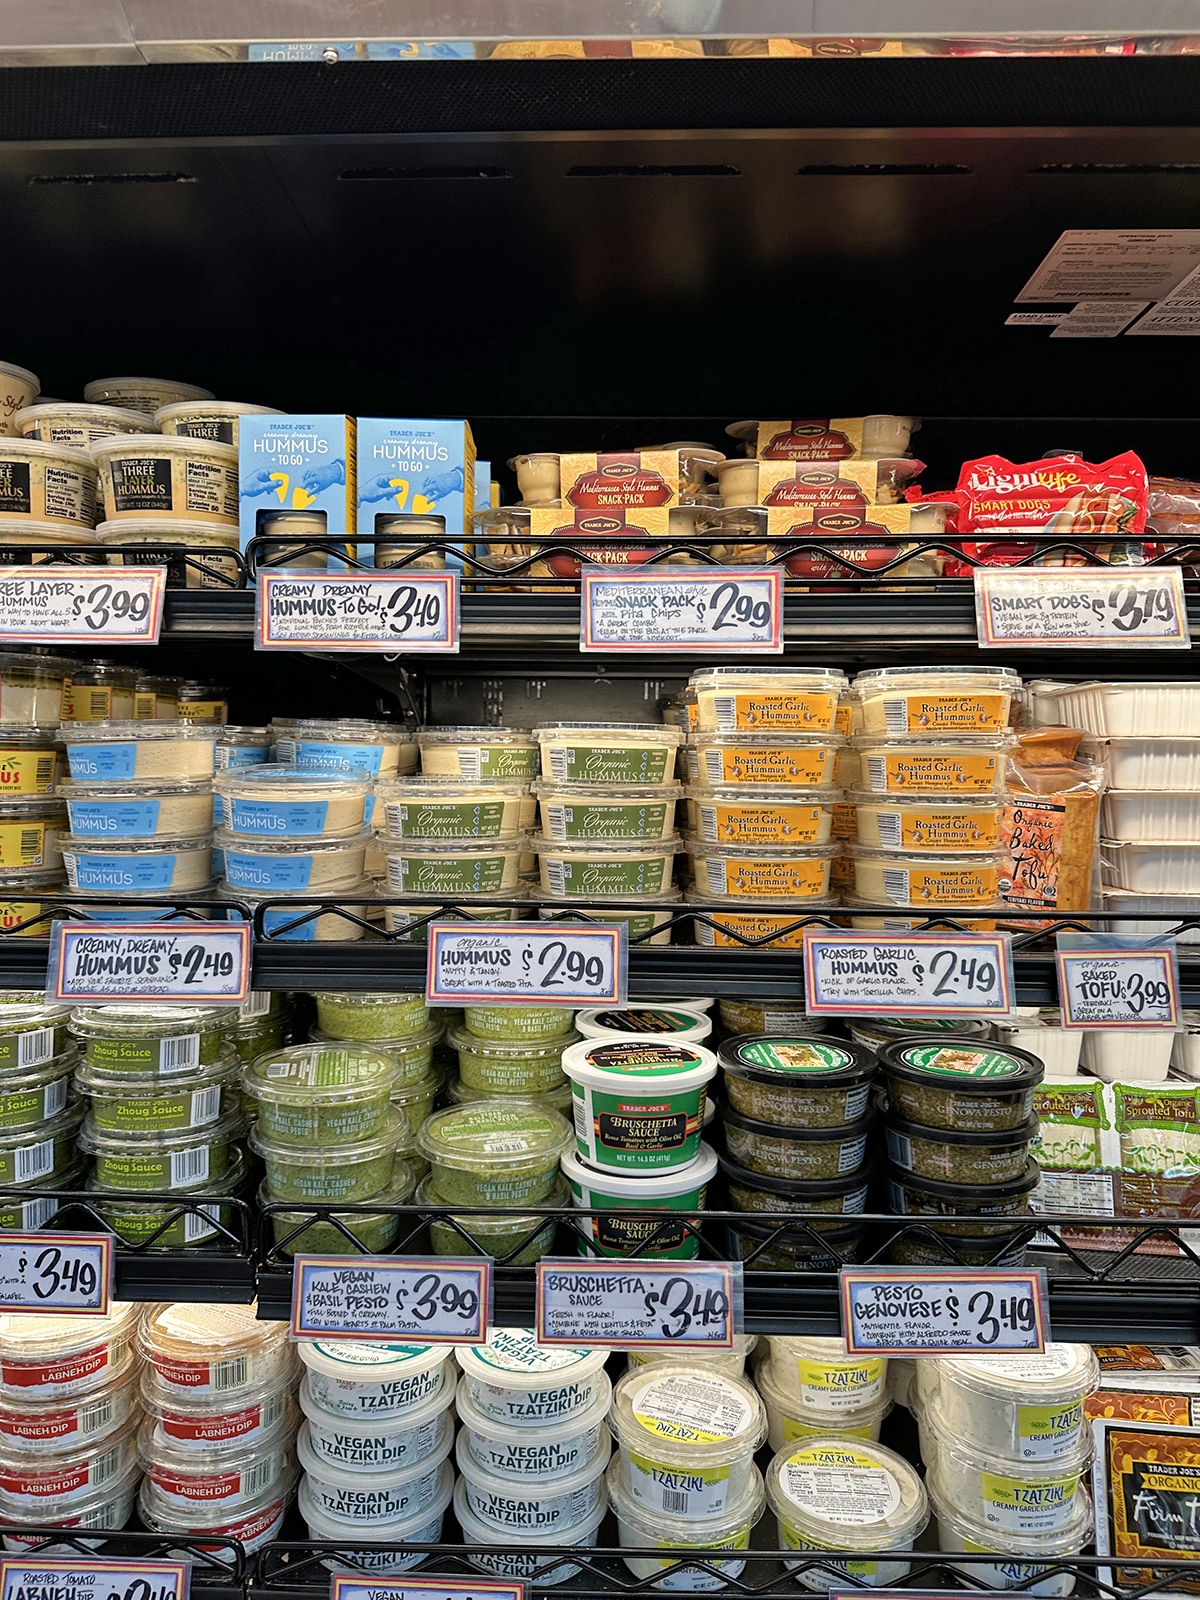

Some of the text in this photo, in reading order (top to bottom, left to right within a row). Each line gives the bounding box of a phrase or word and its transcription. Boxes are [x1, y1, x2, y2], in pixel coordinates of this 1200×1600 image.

[187, 427, 220, 437] THREE
[254, 439, 328, 454] HUMMUS
[373, 445, 449, 461] HUMMUS
[277, 455, 302, 466] TO GO
[397, 461, 423, 473] TO GO
[122, 466, 155, 476] THREE
[188, 463, 222, 474] Nutrition
[188, 470, 209, 478] Facts
[123, 475, 155, 485] LAYER
[117, 485, 167, 496] HUMMUS
[973, 499, 1051, 514] SMART DOGS
[30, 581, 75, 597] LAYER
[271, 584, 373, 598] CREAMY DREAMY
[595, 585, 684, 598] MEDITERRANEAN
[72, 584, 149, 630] $3.99
[271, 586, 441, 634] HUMMUS $3.49
[615, 582, 771, 632] SNACK PACK $2.99
[621, 609, 682, 620] Pita Chips
[991, 596, 1046, 613] SMART
[1047, 594, 1092, 610] DOGS
[1091, 583, 1174, 632] $3.79
[749, 701, 810, 712] Roasted Garlic
[922, 703, 985, 714] Roasted Garlic
[761, 711, 799, 720] Hummus
[934, 713, 975, 722] Hummus
[585, 754, 631, 771] Organic
[734, 756, 796, 766] Roasted Garlic
[579, 770, 638, 782] HUMMUS
[746, 765, 785, 774] Hummus
[234, 816, 287, 830] HUMMUS
[416, 810, 463, 827] Organic
[1013, 808, 1054, 832] Organic
[411, 827, 472, 838] HUMMUS
[1010, 828, 1054, 854] Baked
[78, 871, 134, 885] HUMMUS
[1011, 853, 1049, 890] Tofu
[456, 937, 503, 956] organic
[818, 946, 917, 962] ROASTED GARLIC
[75, 944, 233, 984] HUMMUS $2.49
[440, 941, 604, 988] HUMMUS $2.99
[445, 967, 467, 977] NUTTY
[830, 949, 997, 998] HUMMUS $2.49
[1081, 970, 1117, 982] BAKED
[445, 978, 466, 988] GREAT
[468, 979, 483, 988] WITH
[484, 979, 492, 988] A
[824, 977, 843, 986] KICK
[846, 977, 855, 985] OF
[824, 987, 840, 998] TRY
[844, 988, 860, 996] WITH
[1075, 973, 1171, 1013] TOFU $3.99
[94, 1044, 151, 1058] Zhoug Sauce
[117, 1103, 184, 1117] Zhoug Sauce
[936, 1104, 1012, 1117] GENOVA PESTO
[1163, 1098, 1192, 1108] Organic
[1126, 1104, 1196, 1119] Sprouted Tofu
[609, 1116, 678, 1130] BRUSCHETTA
[628, 1128, 660, 1137] SAUCE
[104, 1159, 163, 1173] Zhoug Sauce
[18, 1248, 97, 1299] $3.49
[333, 1270, 375, 1287] VEGAN
[311, 1280, 392, 1298] KALE, CASHEW
[547, 1275, 647, 1295] BRUSCHETTA
[312, 1273, 478, 1321] BASIL PESTO $3.99
[870, 1284, 925, 1303] PESTO
[569, 1276, 729, 1338] SAUCE $3.49
[854, 1287, 1036, 1345] GENOVESE $3.49
[41, 1358, 101, 1383] LABNEH DIP
[381, 1373, 429, 1395] VEGAN
[824, 1370, 868, 1387] TZATZIKI
[359, 1388, 422, 1408] TZATZIKI
[506, 1386, 592, 1416] TZATZIKI DIP
[527, 1384, 579, 1404] VEGAN
[195, 1419, 253, 1439] LABNEH DIP
[334, 1432, 387, 1449] VEGAN
[320, 1437, 378, 1461] TZATZIKI
[382, 1444, 407, 1460] DIP
[507, 1443, 561, 1458] VEGAN
[489, 1449, 578, 1470] TZATZIKI DIP
[811, 1453, 856, 1465] TZATZIKI
[1148, 1464, 1178, 1475] TRADER
[652, 1467, 704, 1492] TZATZIKI
[1012, 1485, 1065, 1506] TZATZIKI
[992, 1500, 1019, 1513] CREAMY
[1132, 1490, 1184, 1523] Firm
[23, 1572, 97, 1586] ROASTED TOMATO
